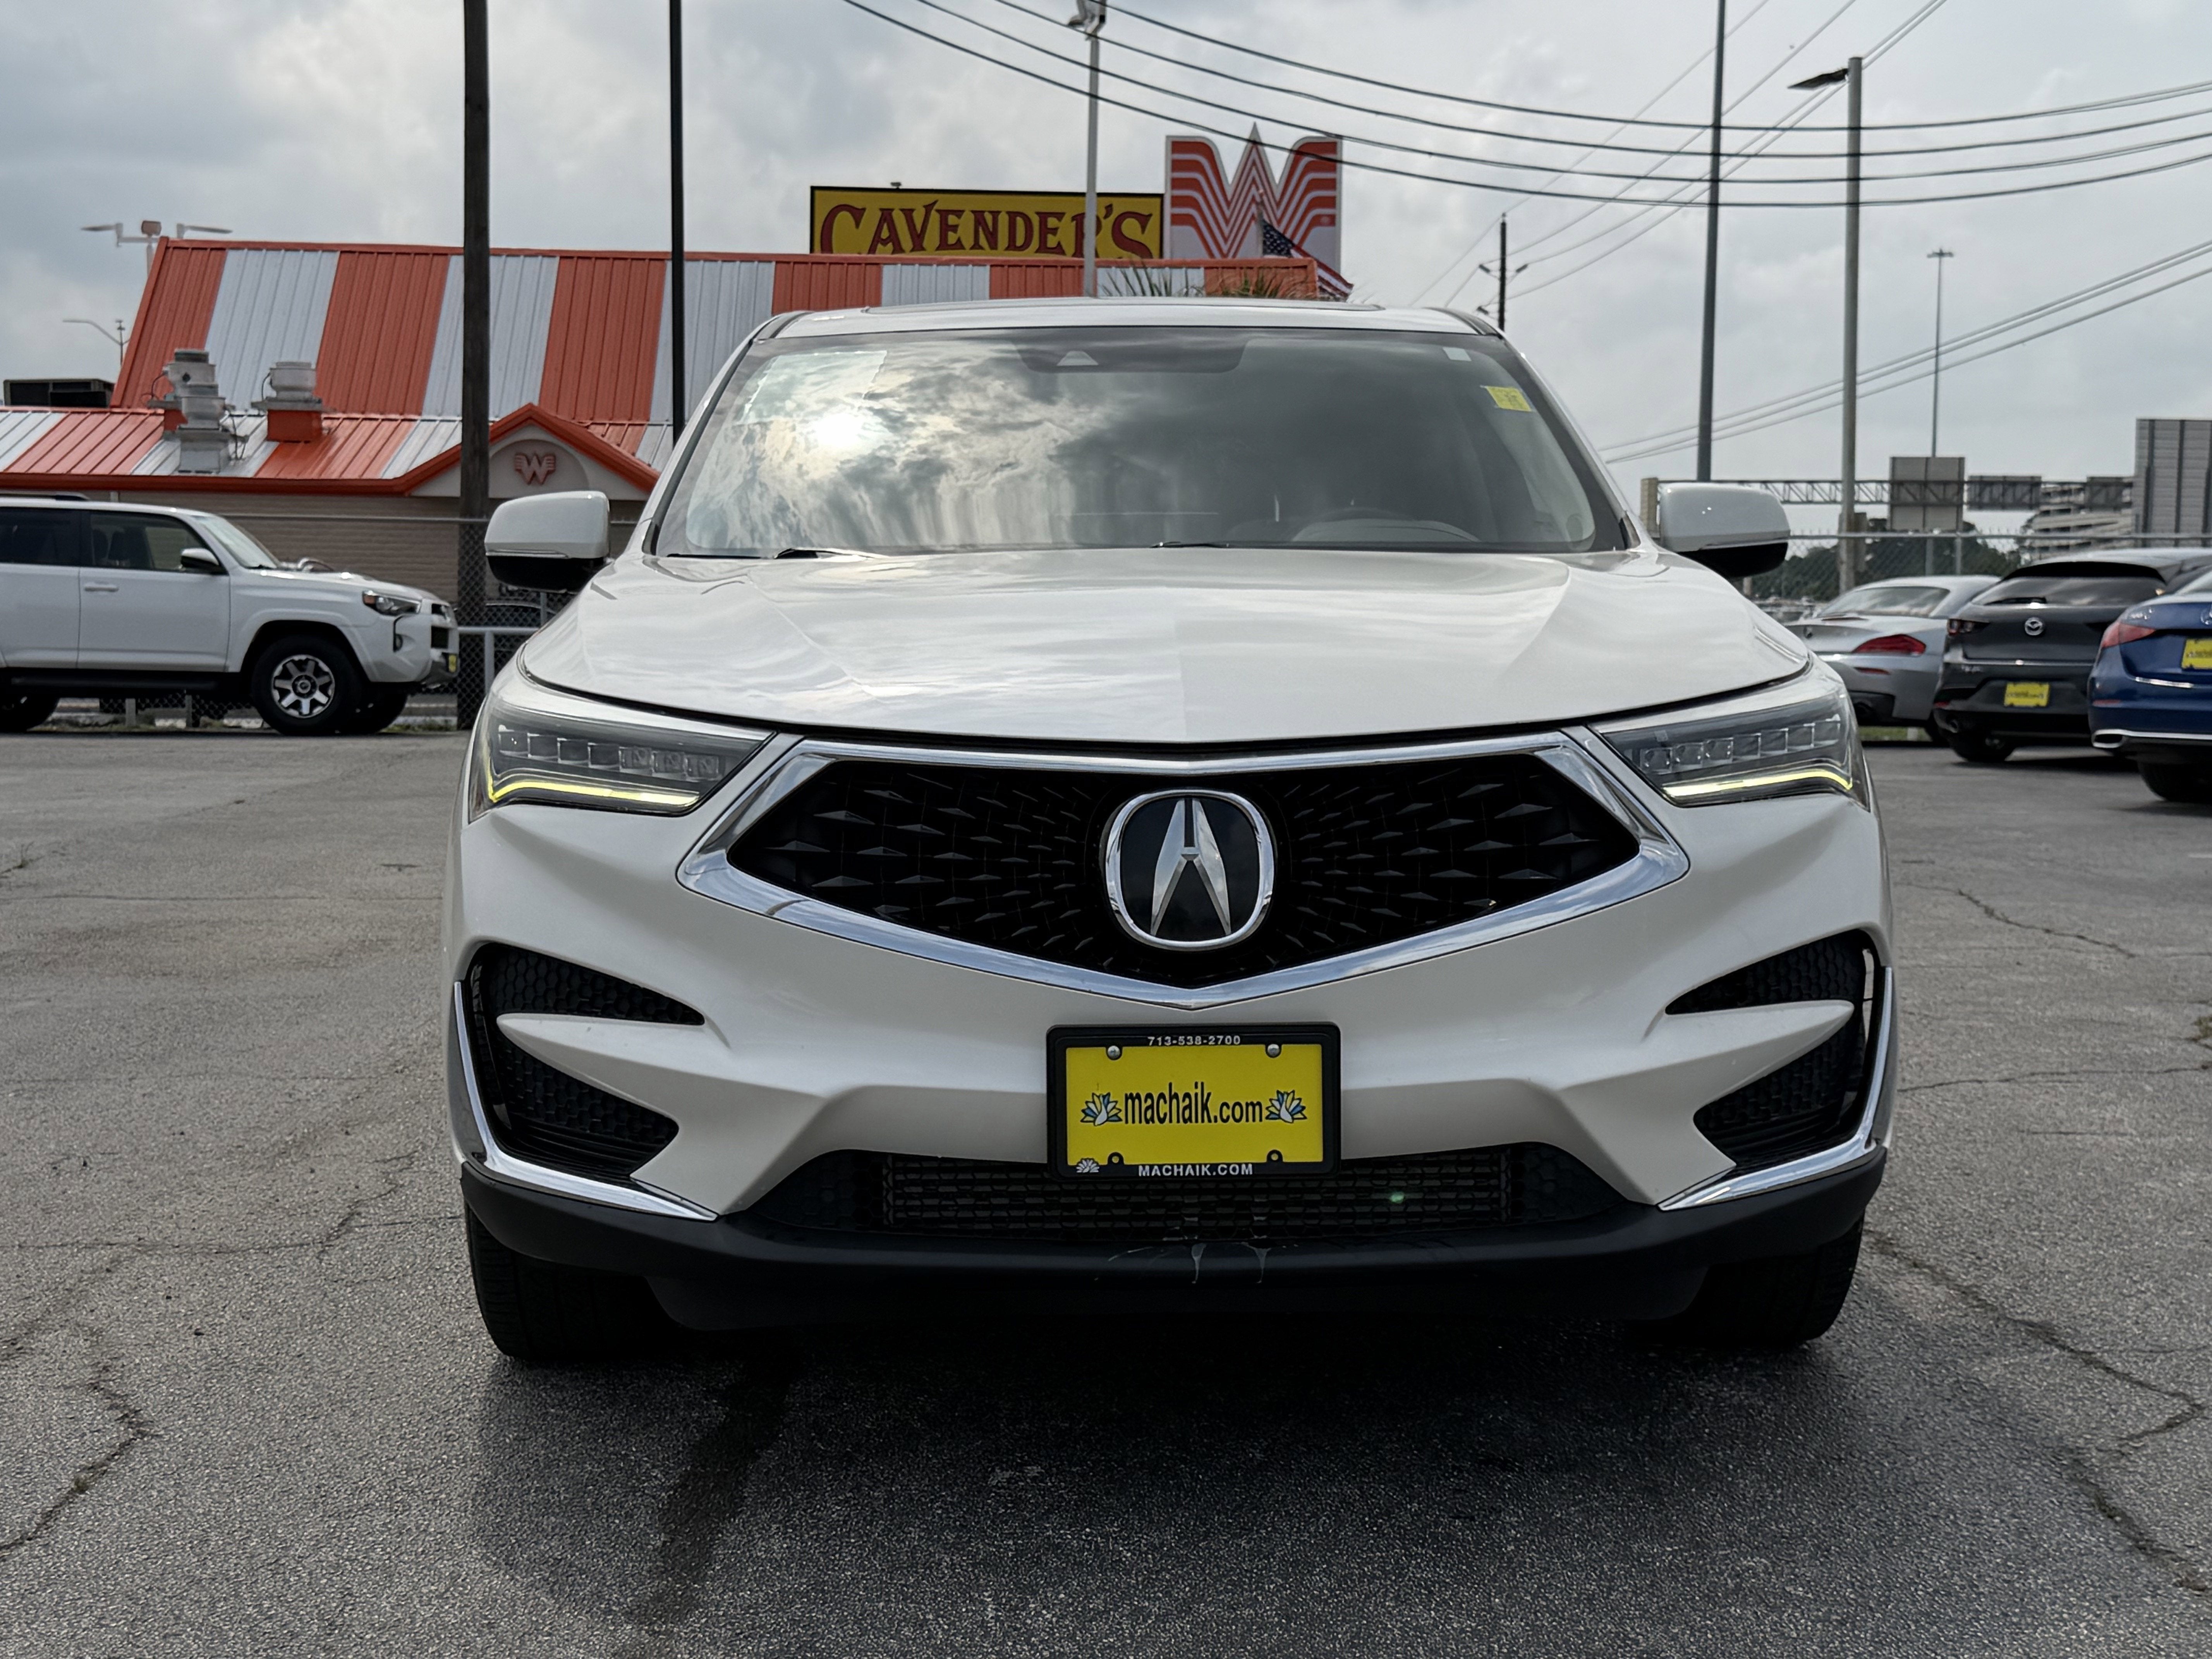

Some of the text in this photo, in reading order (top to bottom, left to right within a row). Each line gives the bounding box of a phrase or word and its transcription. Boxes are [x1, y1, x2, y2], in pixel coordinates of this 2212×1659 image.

[820, 199, 1153, 259] CAVENDER'S
[1147, 1035, 1240, 1046] 713-538-2700
[1124, 1081, 1263, 1124] machaik.com
[1138, 1163, 1253, 1177] MACHAIK.COM
